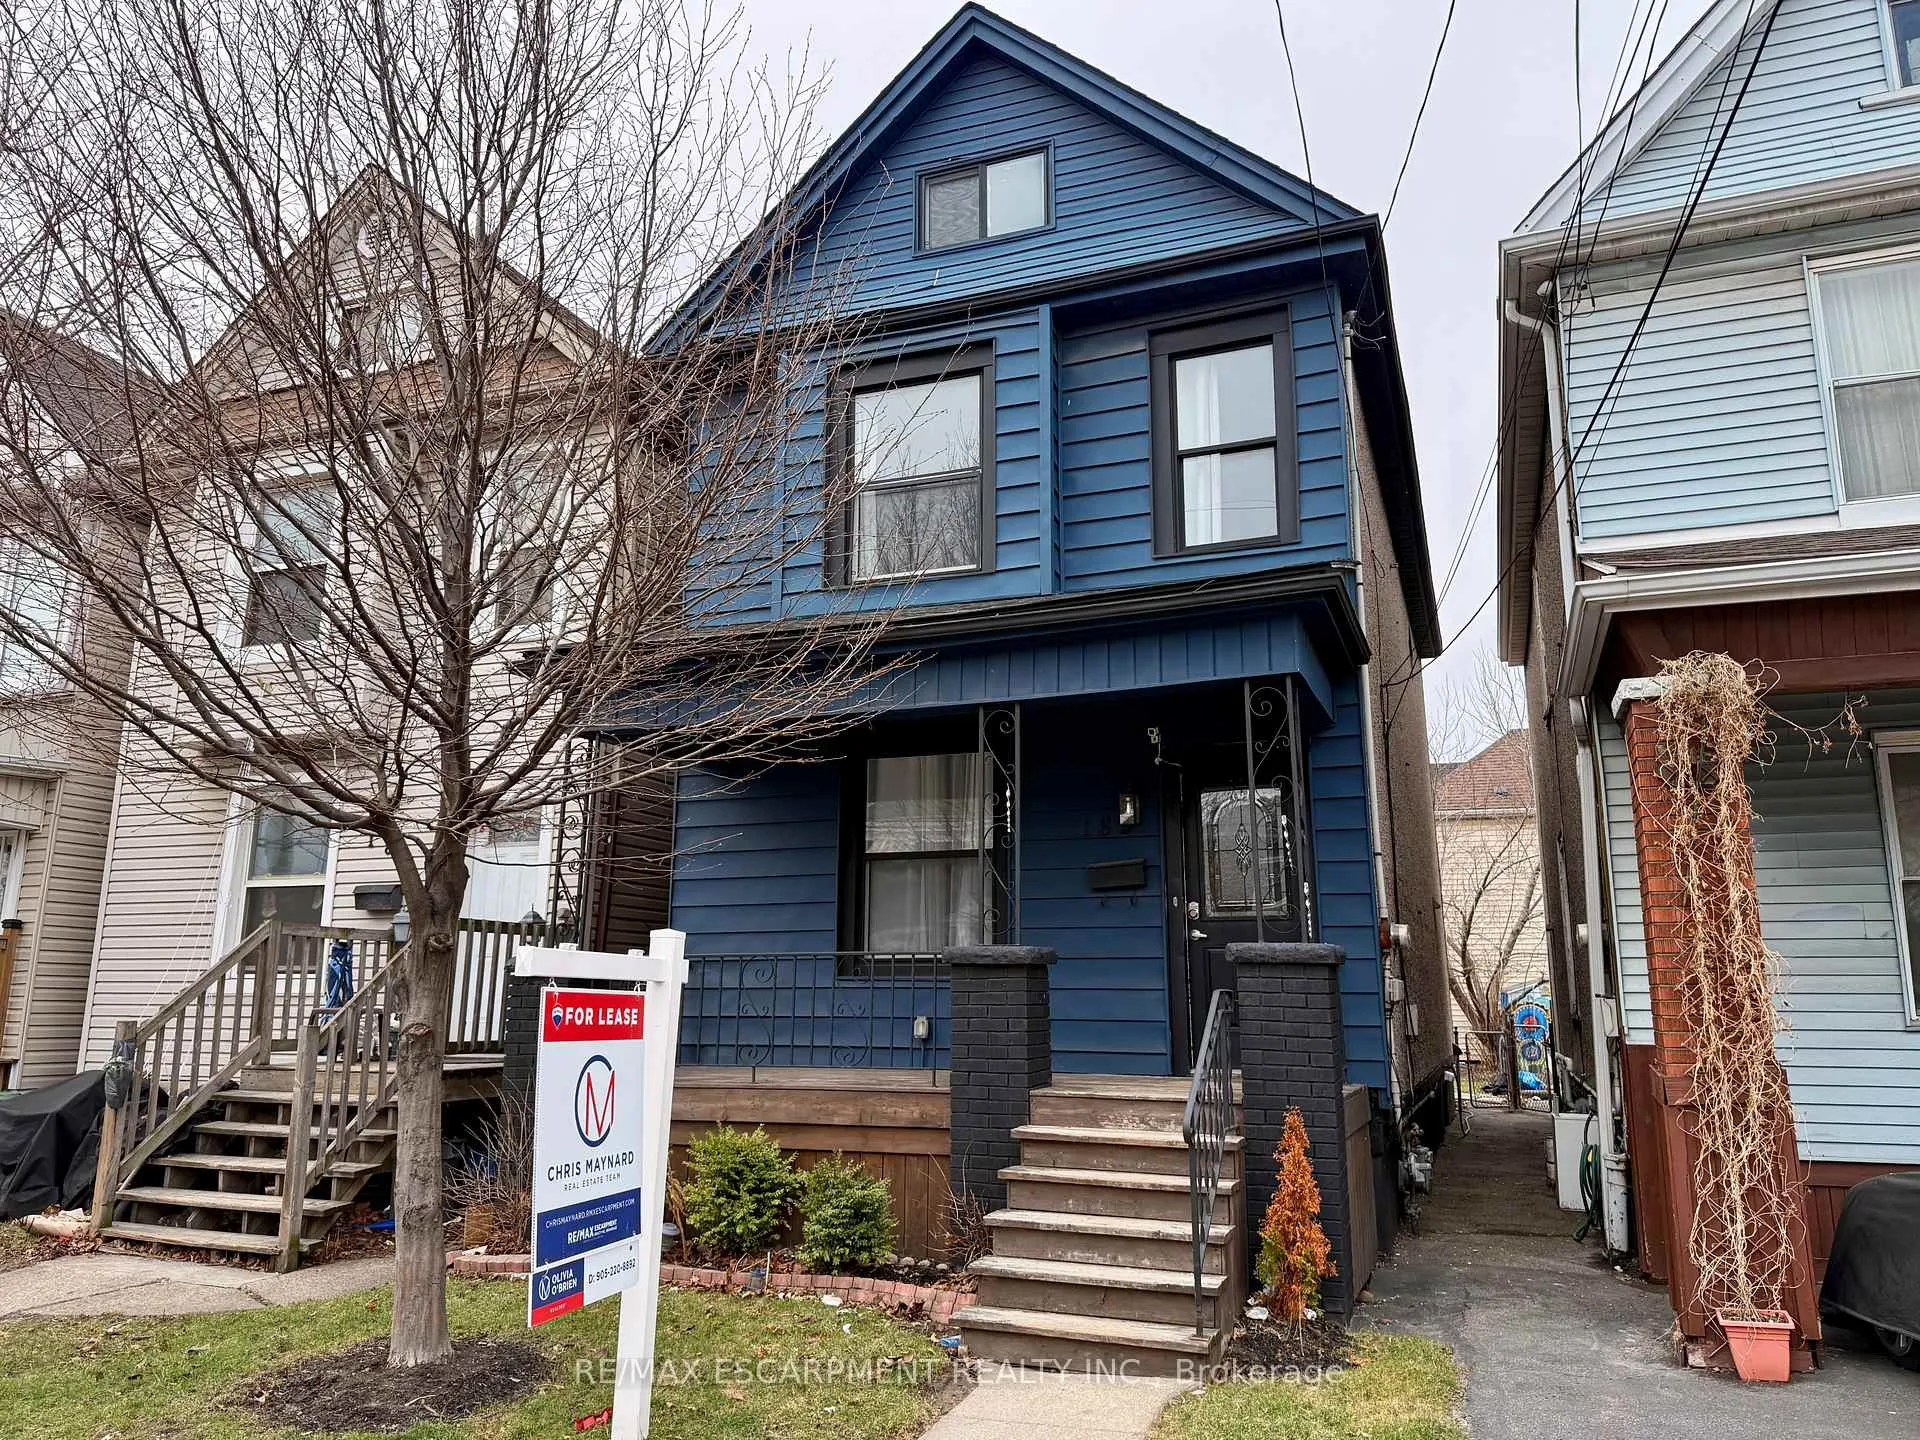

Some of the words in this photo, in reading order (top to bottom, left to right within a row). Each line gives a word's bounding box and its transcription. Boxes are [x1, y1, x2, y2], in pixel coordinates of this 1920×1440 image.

[565, 1007, 593, 1025] FOR
[599, 1008, 639, 1025] LEASE
[547, 1160, 581, 1182] CHRIS
[585, 1150, 635, 1174] MAYNARD
[564, 1183, 580, 1191] REAL
[582, 1175, 604, 1188] ESTATE
[606, 1173, 621, 1182] TEAM
[567, 1225, 594, 1245] RE/MAX
[551, 1268, 574, 1285] OLIVIA
[551, 1277, 577, 1296] O'BRIEN
